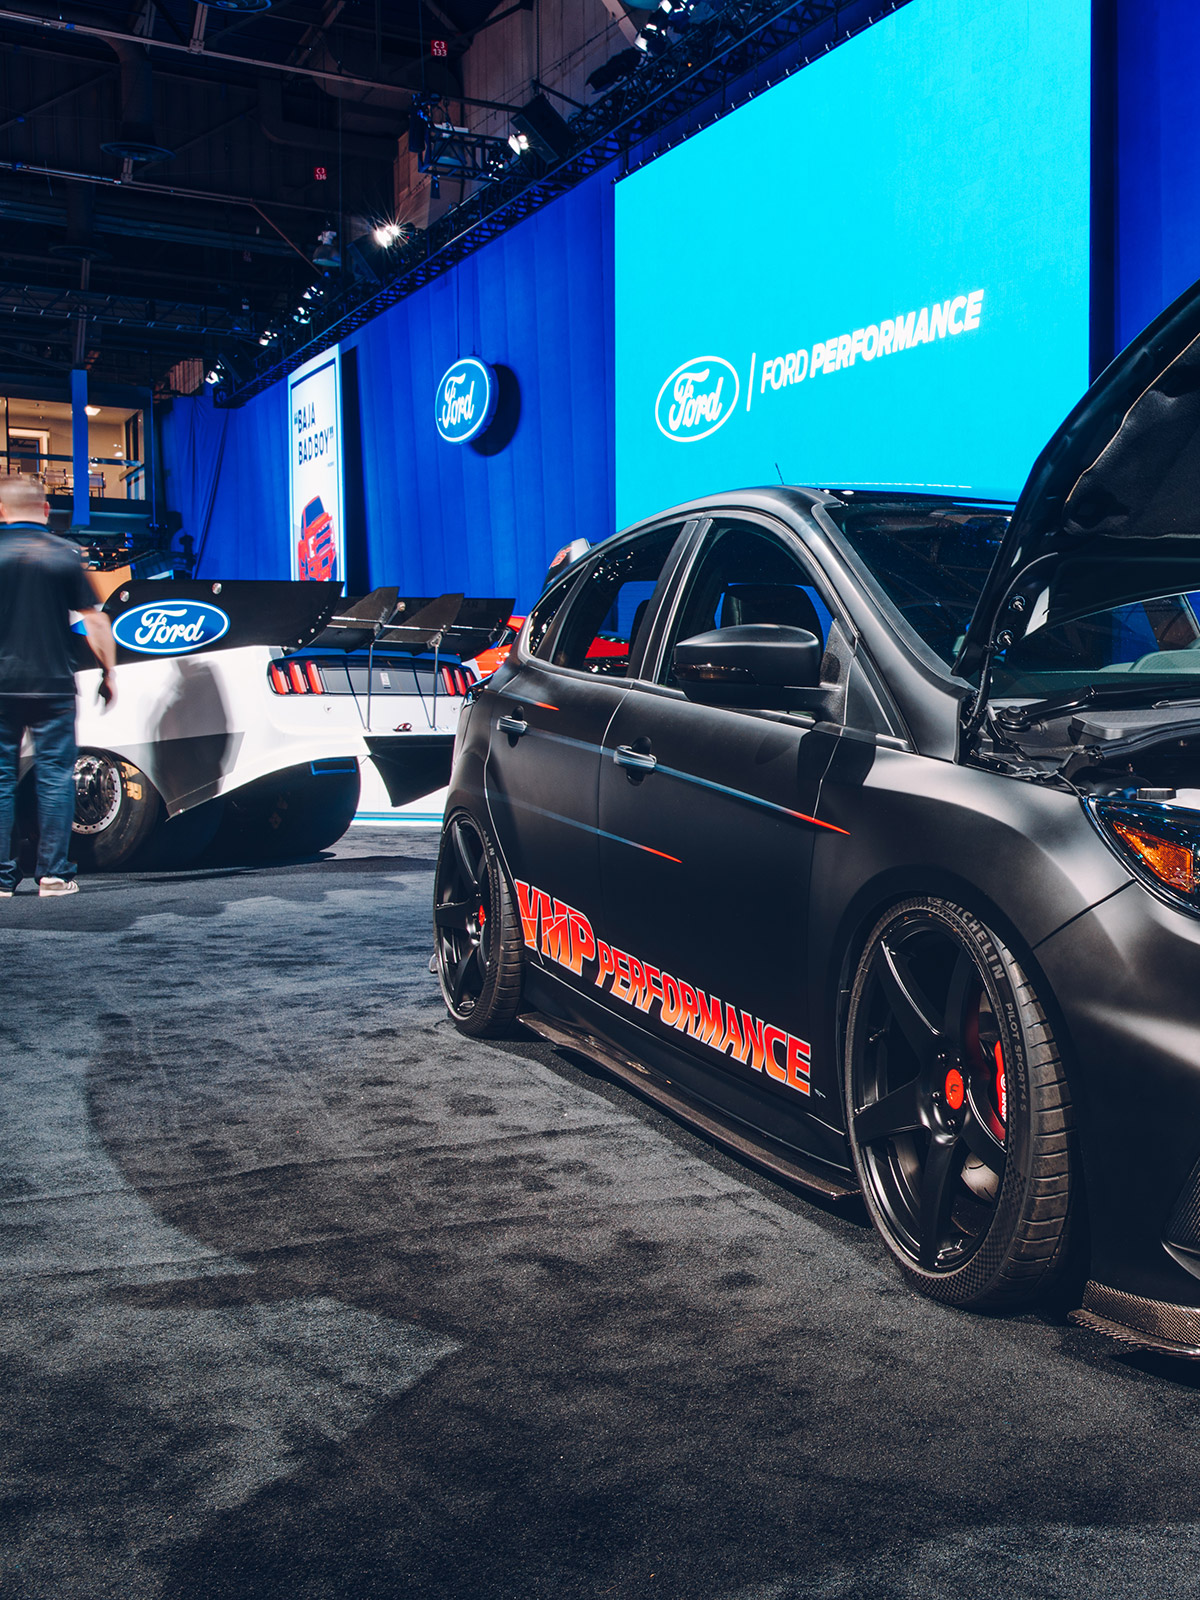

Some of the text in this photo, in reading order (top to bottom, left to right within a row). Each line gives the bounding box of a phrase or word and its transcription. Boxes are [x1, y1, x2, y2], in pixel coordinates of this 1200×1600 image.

[761, 289, 984, 394] FORD PERFORMANCE
[442, 372, 475, 429] Ford
[668, 368, 724, 431] Ford
[134, 608, 205, 645] Ford
[945, 900, 1005, 980] MICHELIN
[514, 878, 812, 1097] VMP PERFORMANCE
[1005, 1002, 1020, 1040] PILOT
